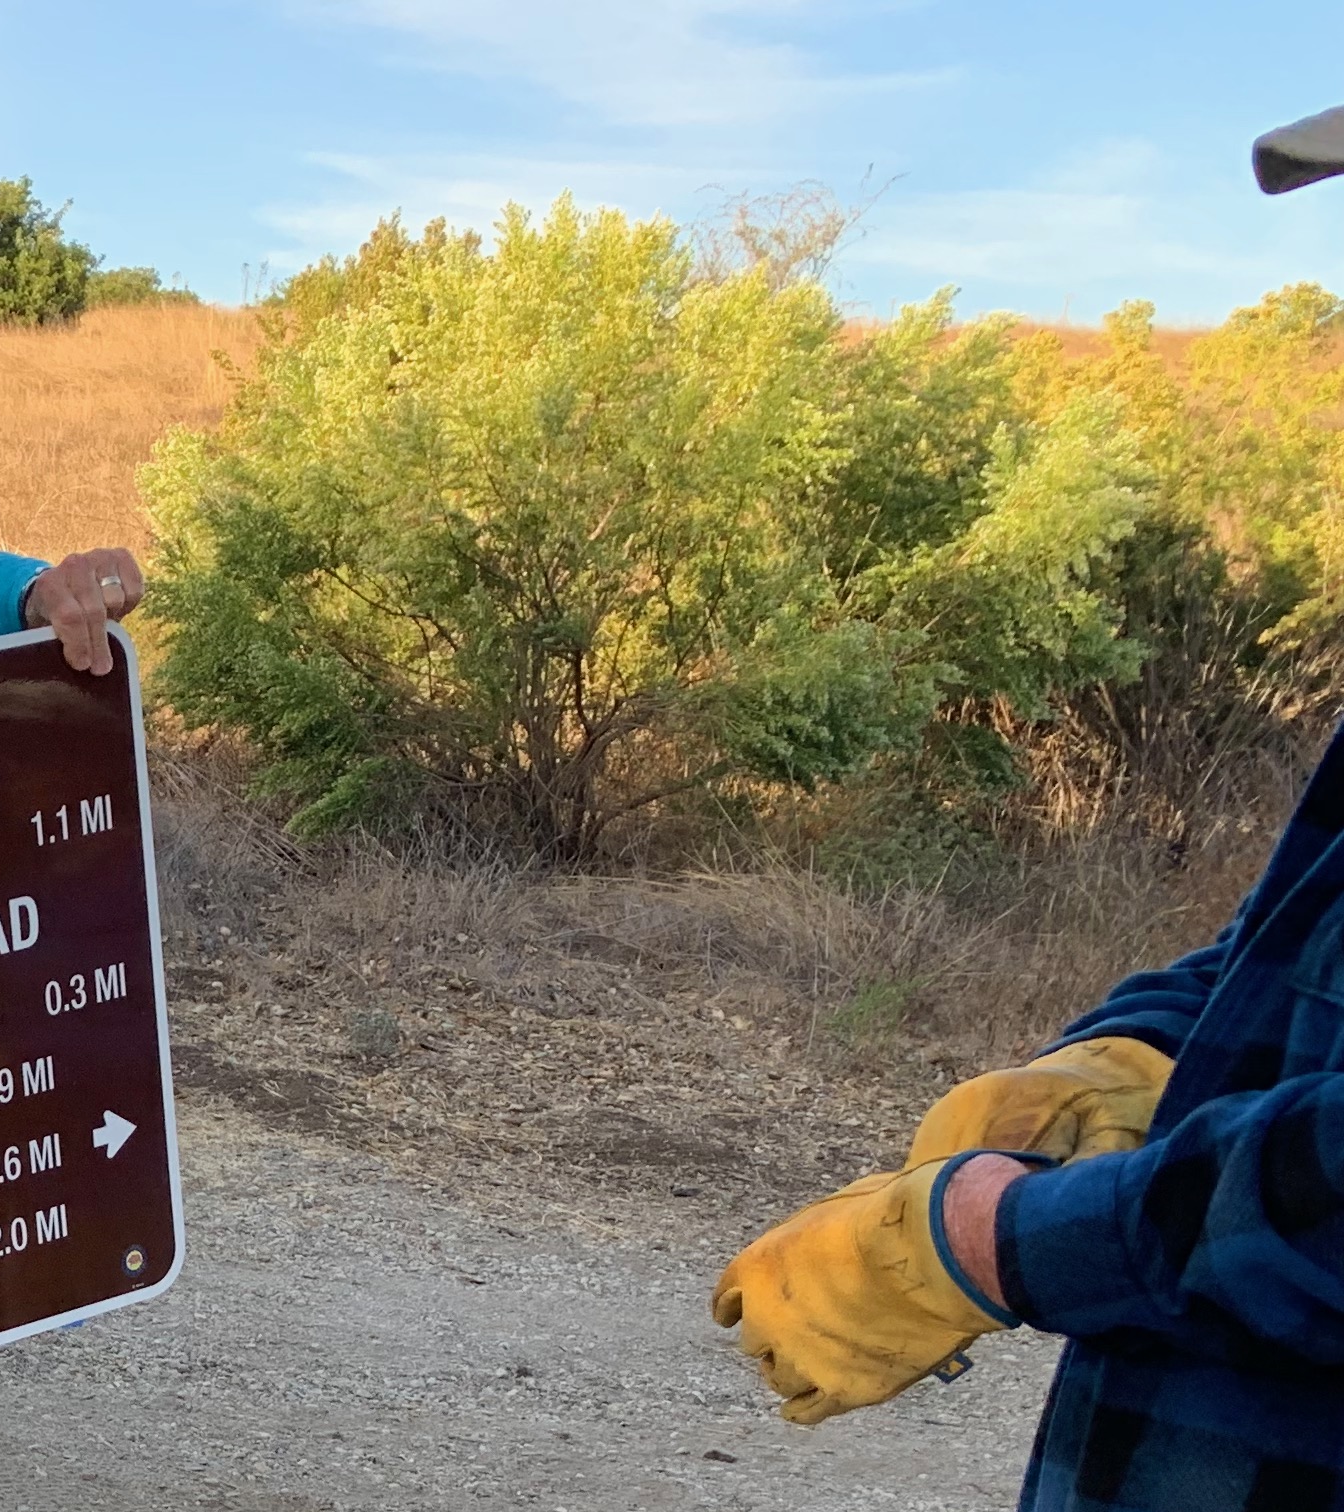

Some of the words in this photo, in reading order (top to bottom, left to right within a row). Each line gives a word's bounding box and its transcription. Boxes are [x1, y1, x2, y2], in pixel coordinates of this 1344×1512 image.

[30, 805, 69, 846] 1.1
[81, 795, 113, 835] MI
[45, 974, 87, 1015] 0.3
[94, 963, 126, 1003] MI
[22, 1056, 54, 1096] MI
[29, 1134, 62, 1174] MI
[36, 1204, 68, 1244] MI
